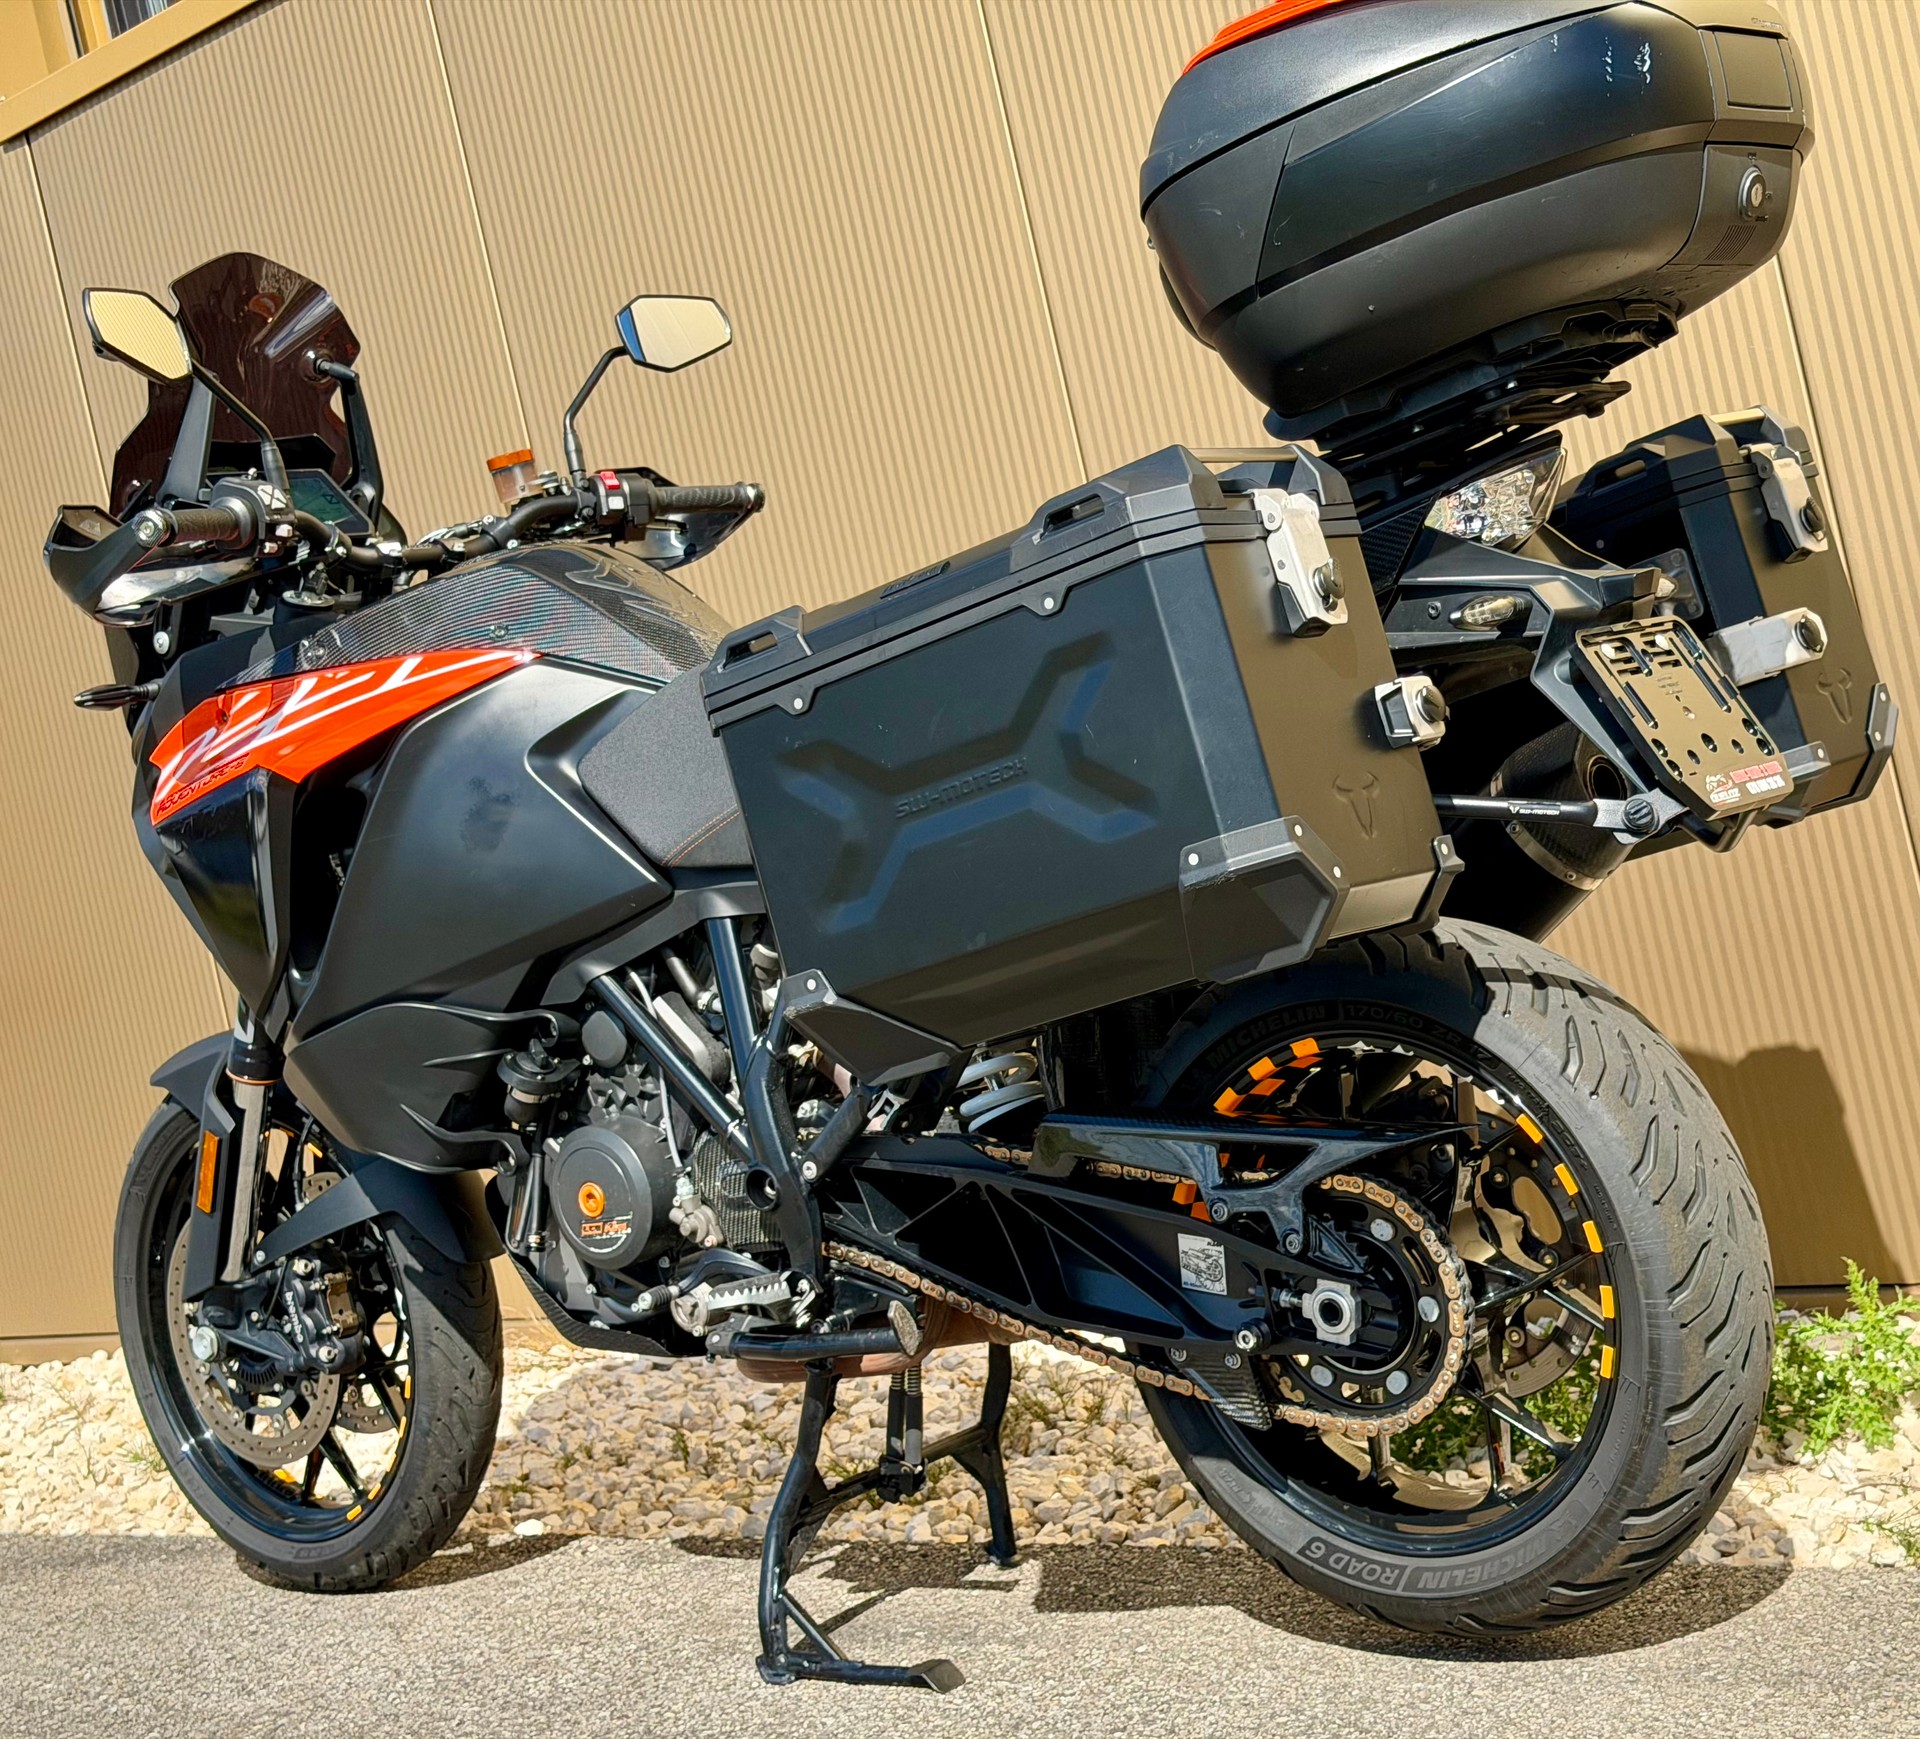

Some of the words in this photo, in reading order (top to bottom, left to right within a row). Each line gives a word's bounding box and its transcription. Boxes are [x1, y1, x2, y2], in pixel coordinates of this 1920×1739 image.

[1207, 1004, 1327, 1068] MICHELIN
[285, 1291, 304, 1343] brembo
[1305, 1541, 1327, 1560] 6
[1328, 1551, 1401, 1587] ROAD
[1417, 1531, 1553, 1590] MICHELIN
